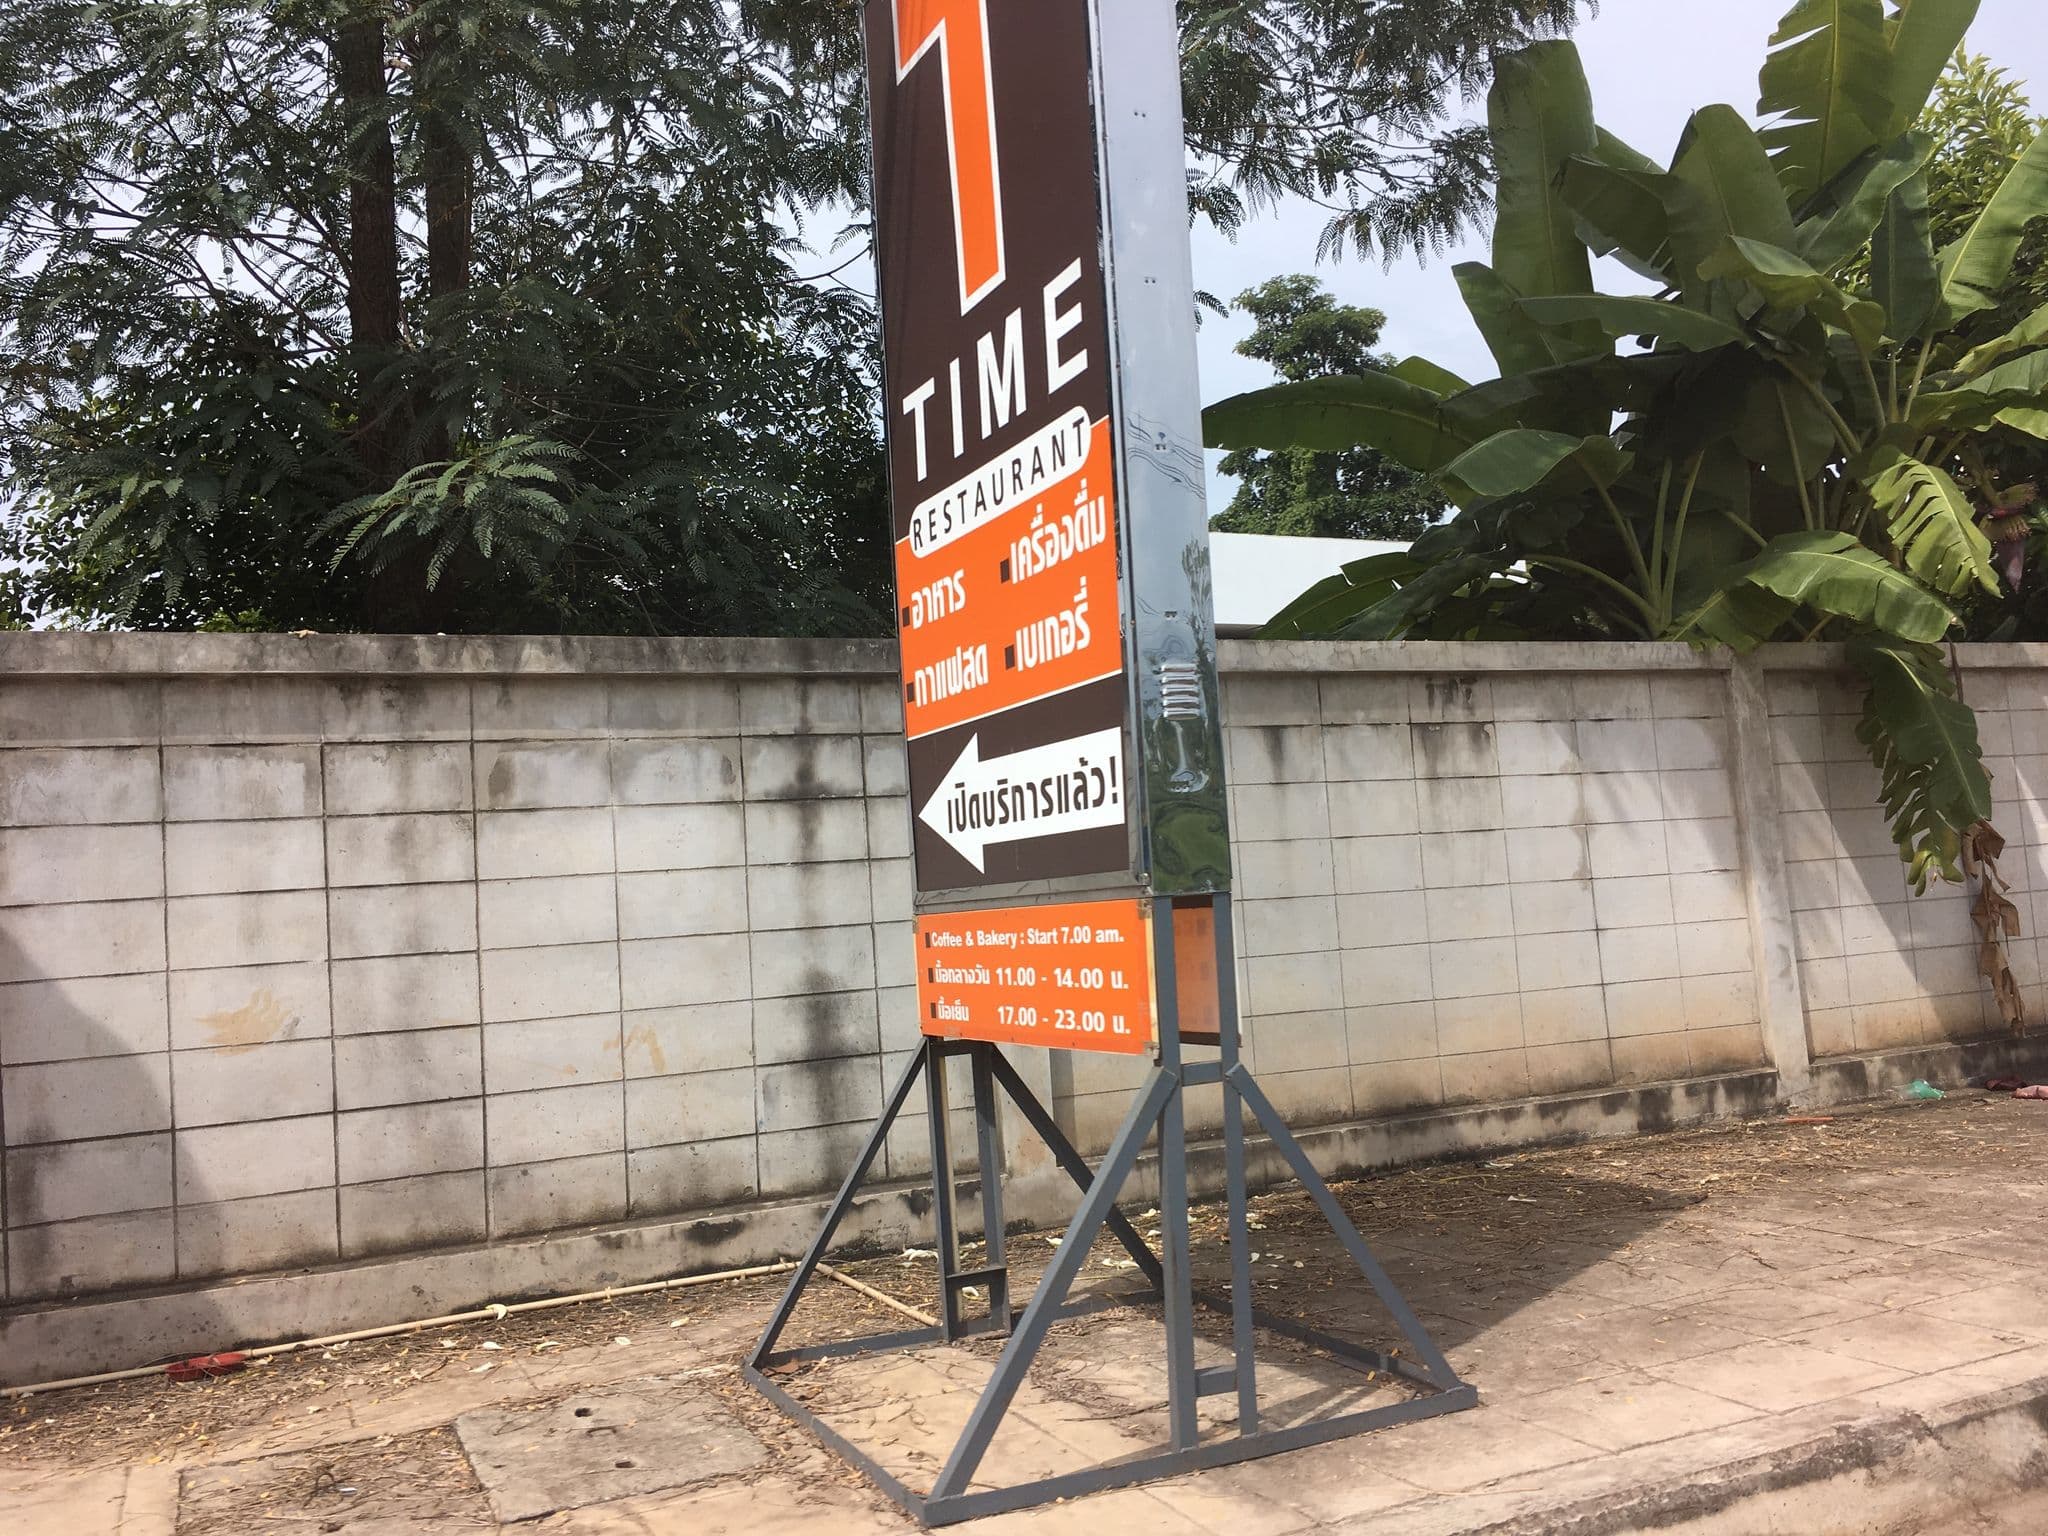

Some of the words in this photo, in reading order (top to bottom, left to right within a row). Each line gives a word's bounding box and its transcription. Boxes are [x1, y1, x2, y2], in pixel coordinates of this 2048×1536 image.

[892, 0, 1006, 317] 1
[902, 257, 1089, 482] TIME
[913, 416, 1085, 551] RESTAURANT
[1010, 477, 1107, 584] เครื่องดื่ม
[911, 569, 966, 629] อาหาร
[1015, 575, 1091, 671] เบเกอรี่
[914, 643, 989, 708] กาแฟสด
[947, 756, 1118, 834] เปิดบริการแล้ว!
[930, 931, 963, 948] Coffee
[965, 930, 974, 947] &
[976, 930, 1018, 950] Bakery
[1027, 927, 1059, 945] Start
[1060, 925, 1092, 944] 7.00
[1095, 928, 1125, 943] am.
[934, 959, 991, 985] มื้อกลางวัน
[995, 966, 1036, 987] 11.00
[1053, 967, 1104, 990] 14.00
[1110, 970, 1129, 990] น.
[937, 995, 970, 1022] มื้อเย็น
[997, 1005, 1038, 1028] 17.00
[1054, 1008, 1106, 1033] 23.00
[1111, 1014, 1131, 1035] น.
